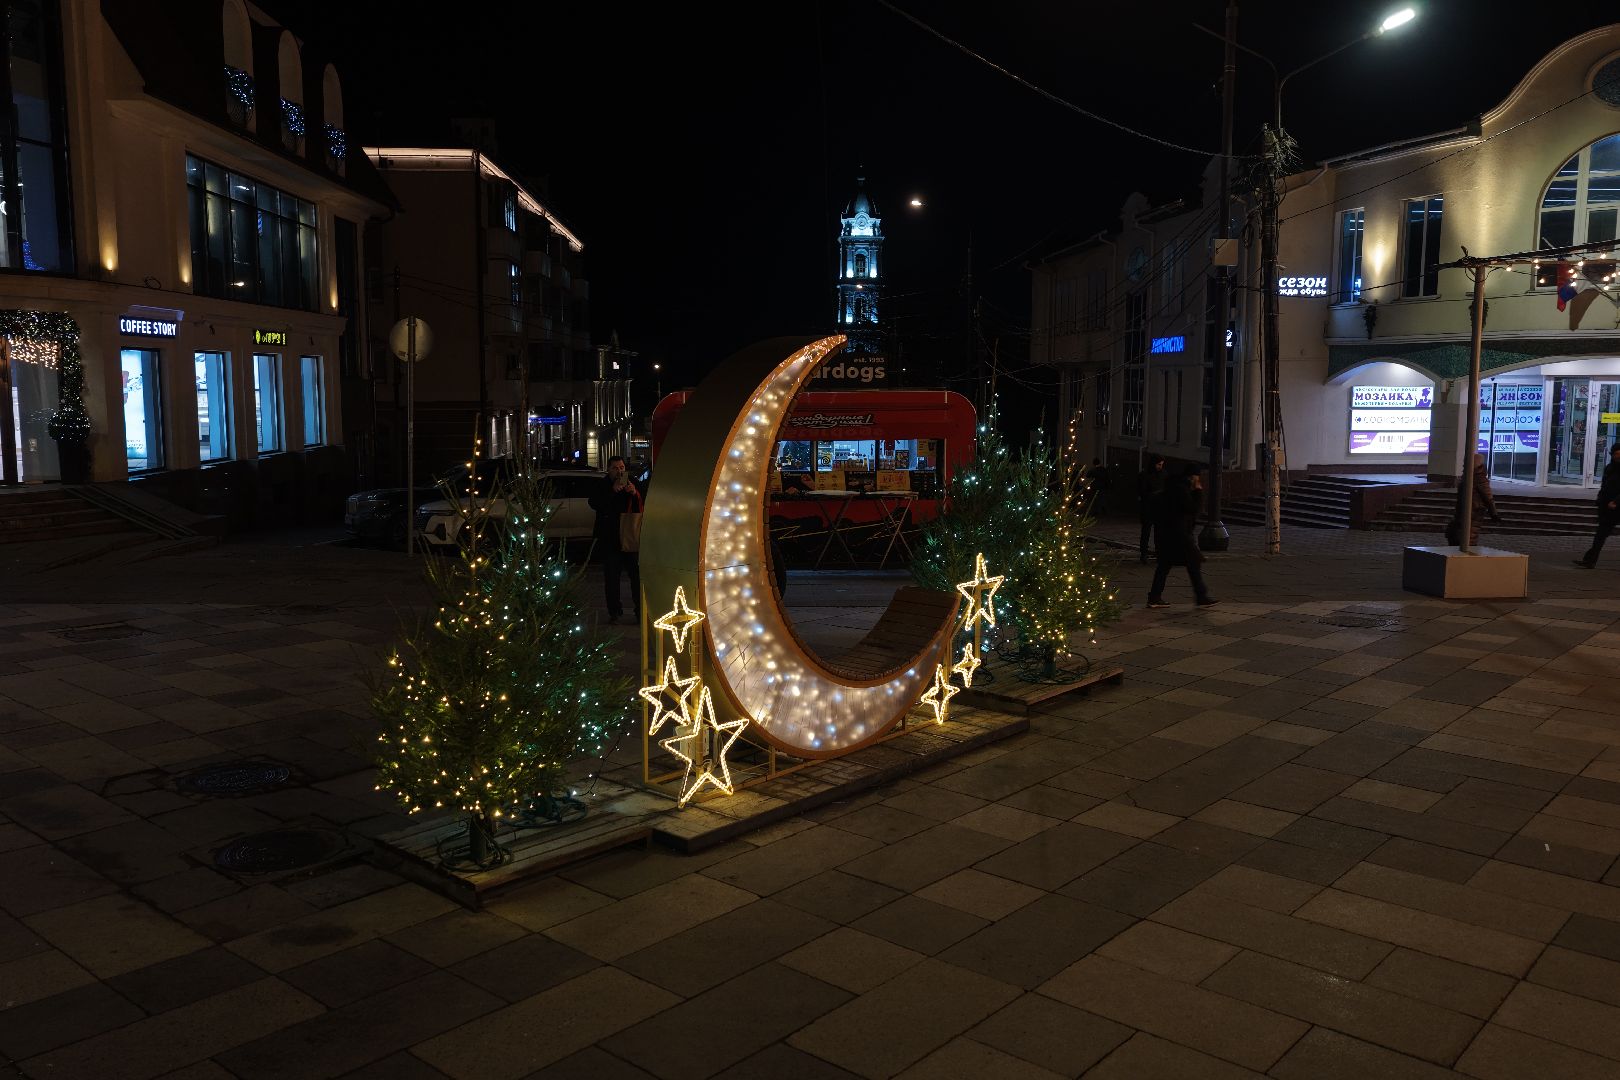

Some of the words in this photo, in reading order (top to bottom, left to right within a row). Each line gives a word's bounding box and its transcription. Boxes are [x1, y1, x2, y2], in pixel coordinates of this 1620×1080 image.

[1278, 277, 1327, 288] сезон
[1279, 288, 1299, 297] жда
[1300, 287, 1327, 297] обувь
[120, 318, 152, 334] COFFEE
[153, 321, 177, 336] STORY
[812, 363, 885, 382] ardogs
